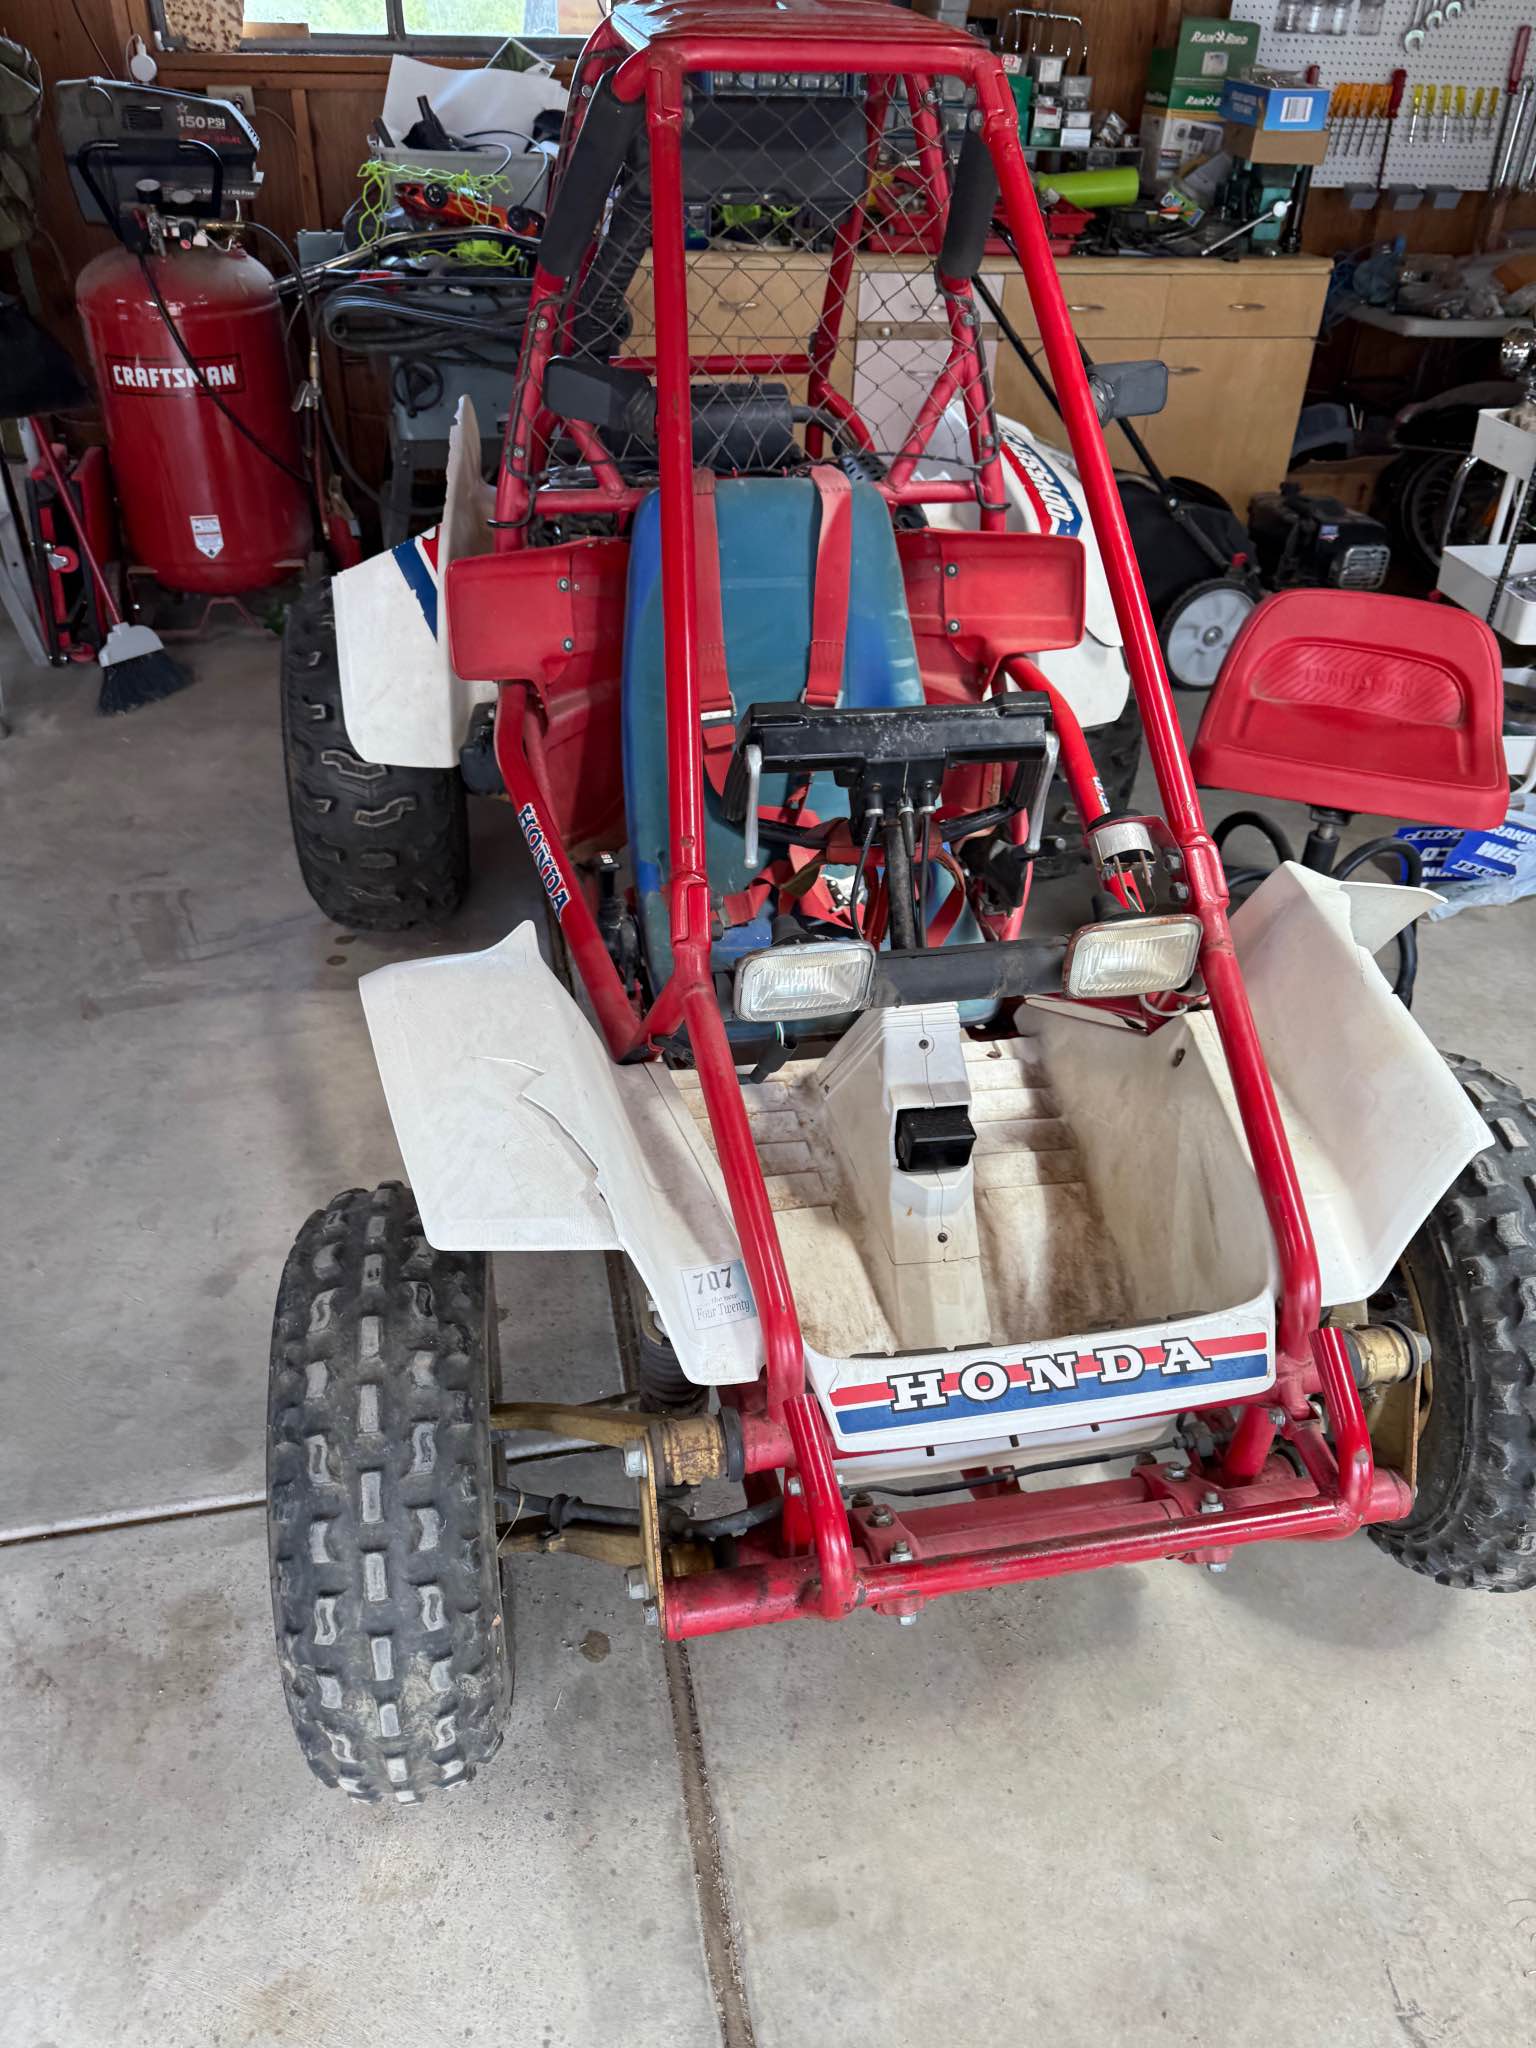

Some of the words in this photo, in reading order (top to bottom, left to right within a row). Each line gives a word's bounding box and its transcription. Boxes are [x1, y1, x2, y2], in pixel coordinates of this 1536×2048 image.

[1191, 31, 1216, 43] RAIN
[1185, 96, 1207, 106] RAIN
[177, 115, 206, 129] 150
[207, 117, 225, 129] PSI
[113, 364, 237, 388] CRAFTSMAN
[518, 802, 571, 924] HONDA
[692, 1266, 732, 1295] 707
[696, 1307, 716, 1321] Four
[718, 1300, 750, 1316] Twenty
[887, 1336, 1213, 1412] HONDA
